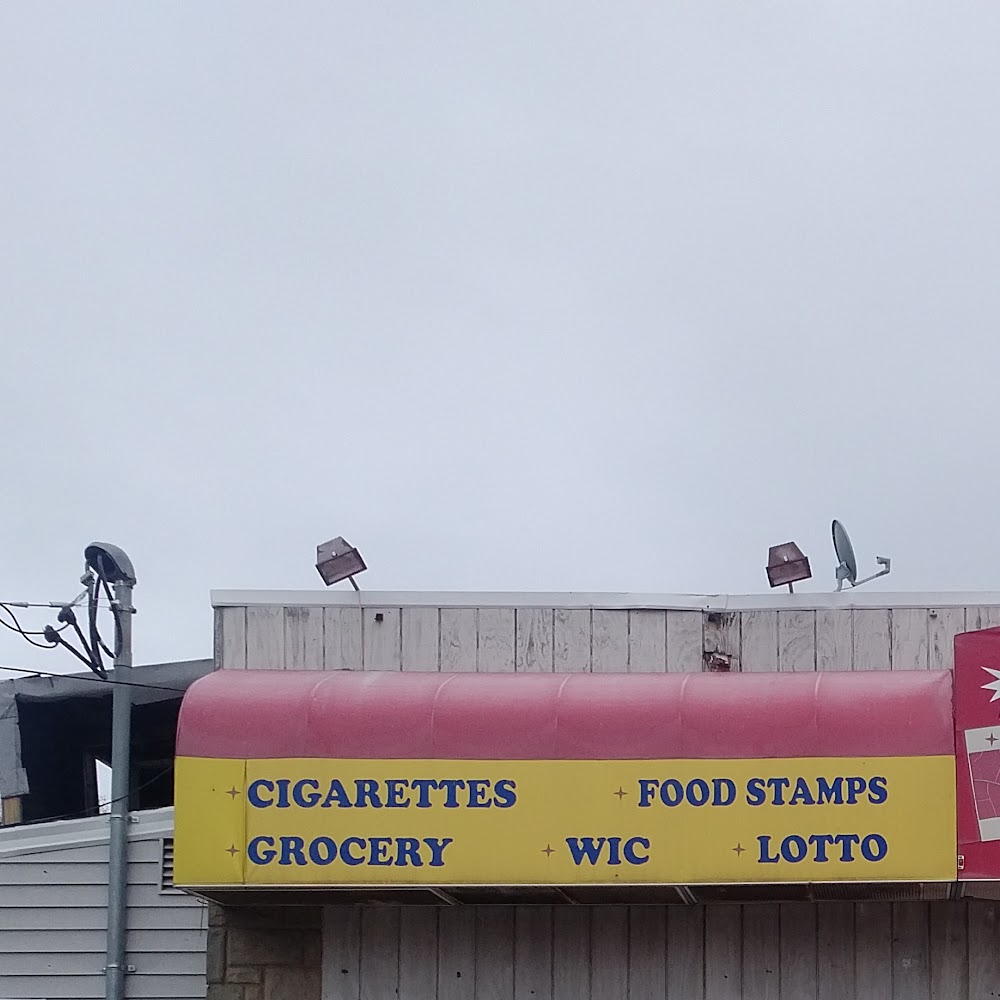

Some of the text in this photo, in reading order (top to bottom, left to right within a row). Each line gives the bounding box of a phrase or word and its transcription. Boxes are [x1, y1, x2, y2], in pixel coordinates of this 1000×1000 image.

[247, 779, 517, 809] CIGARETTES
[638, 776, 888, 807] FOOD STAMPS
[247, 836, 453, 867] GROCERY
[566, 836, 650, 865] WIC
[757, 833, 888, 863] LOTTO
